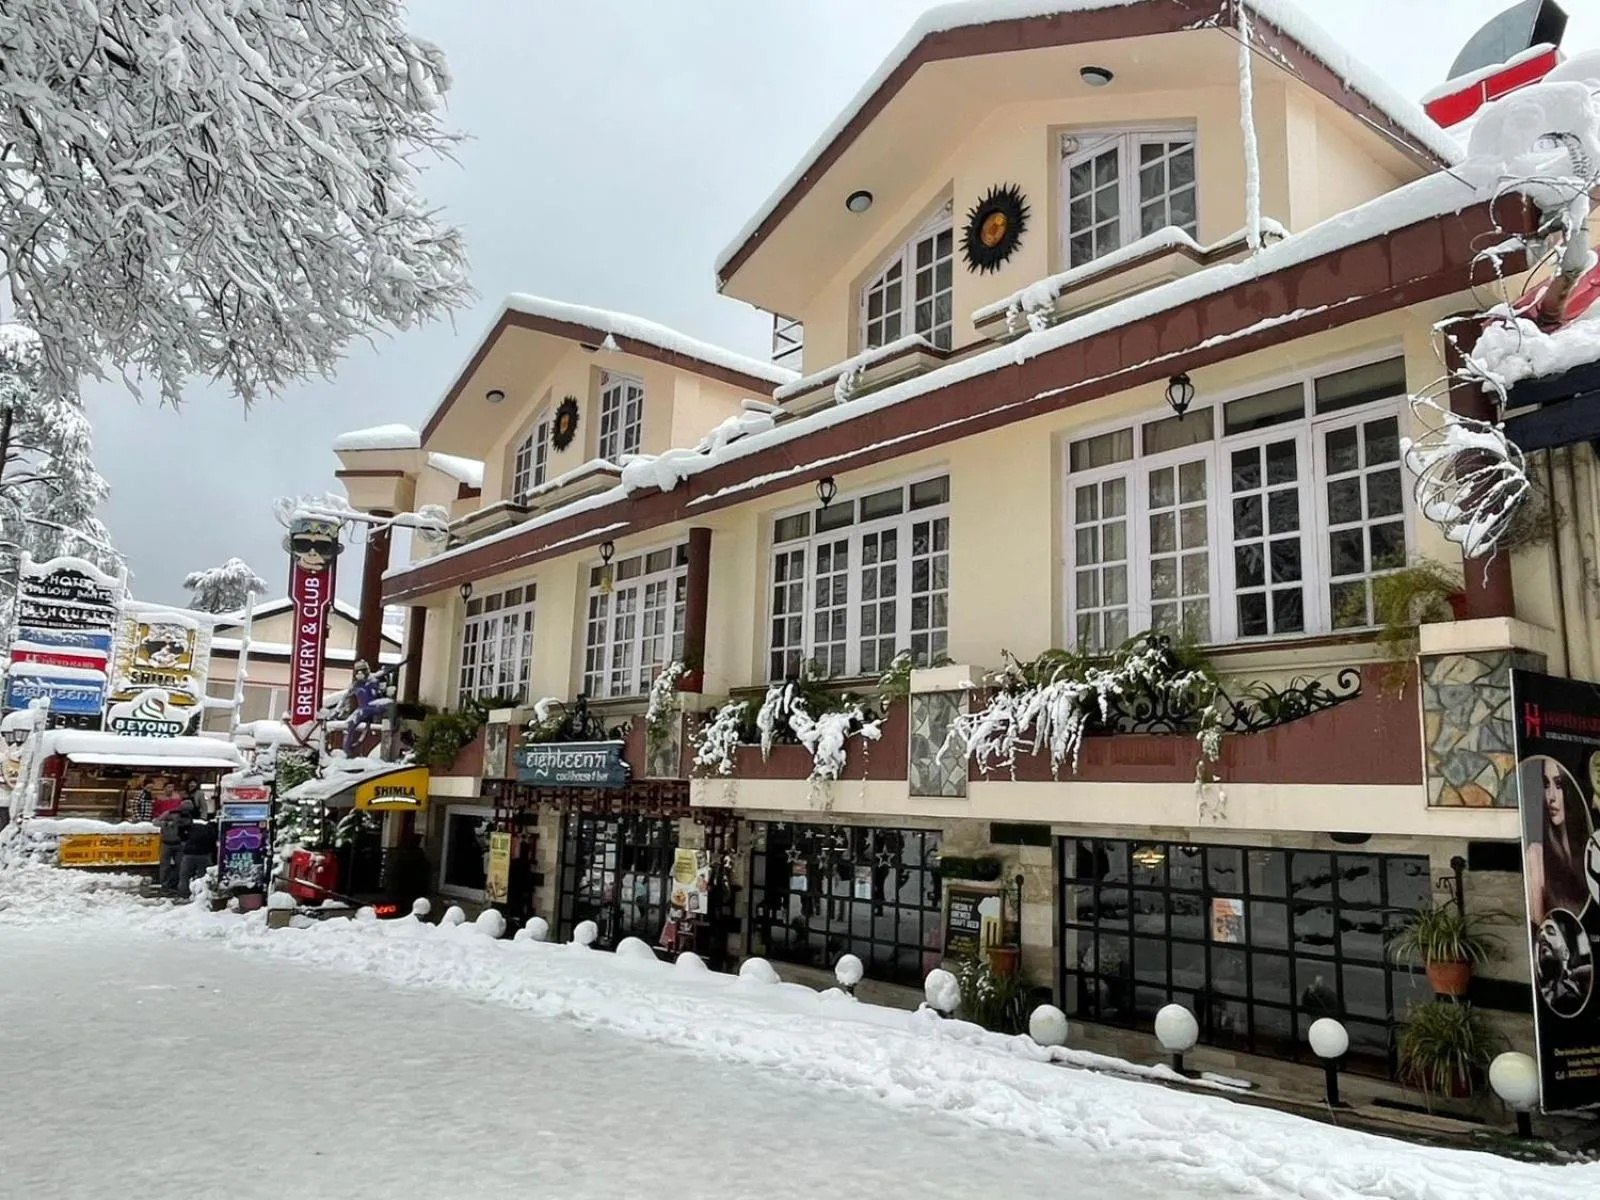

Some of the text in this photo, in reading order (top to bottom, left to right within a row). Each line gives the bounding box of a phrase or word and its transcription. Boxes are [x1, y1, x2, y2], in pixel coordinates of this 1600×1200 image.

[297, 577, 320, 715] BREWERY & CLUB
[115, 719, 180, 734] BEYOND
[374, 785, 416, 798] SHIMLA
